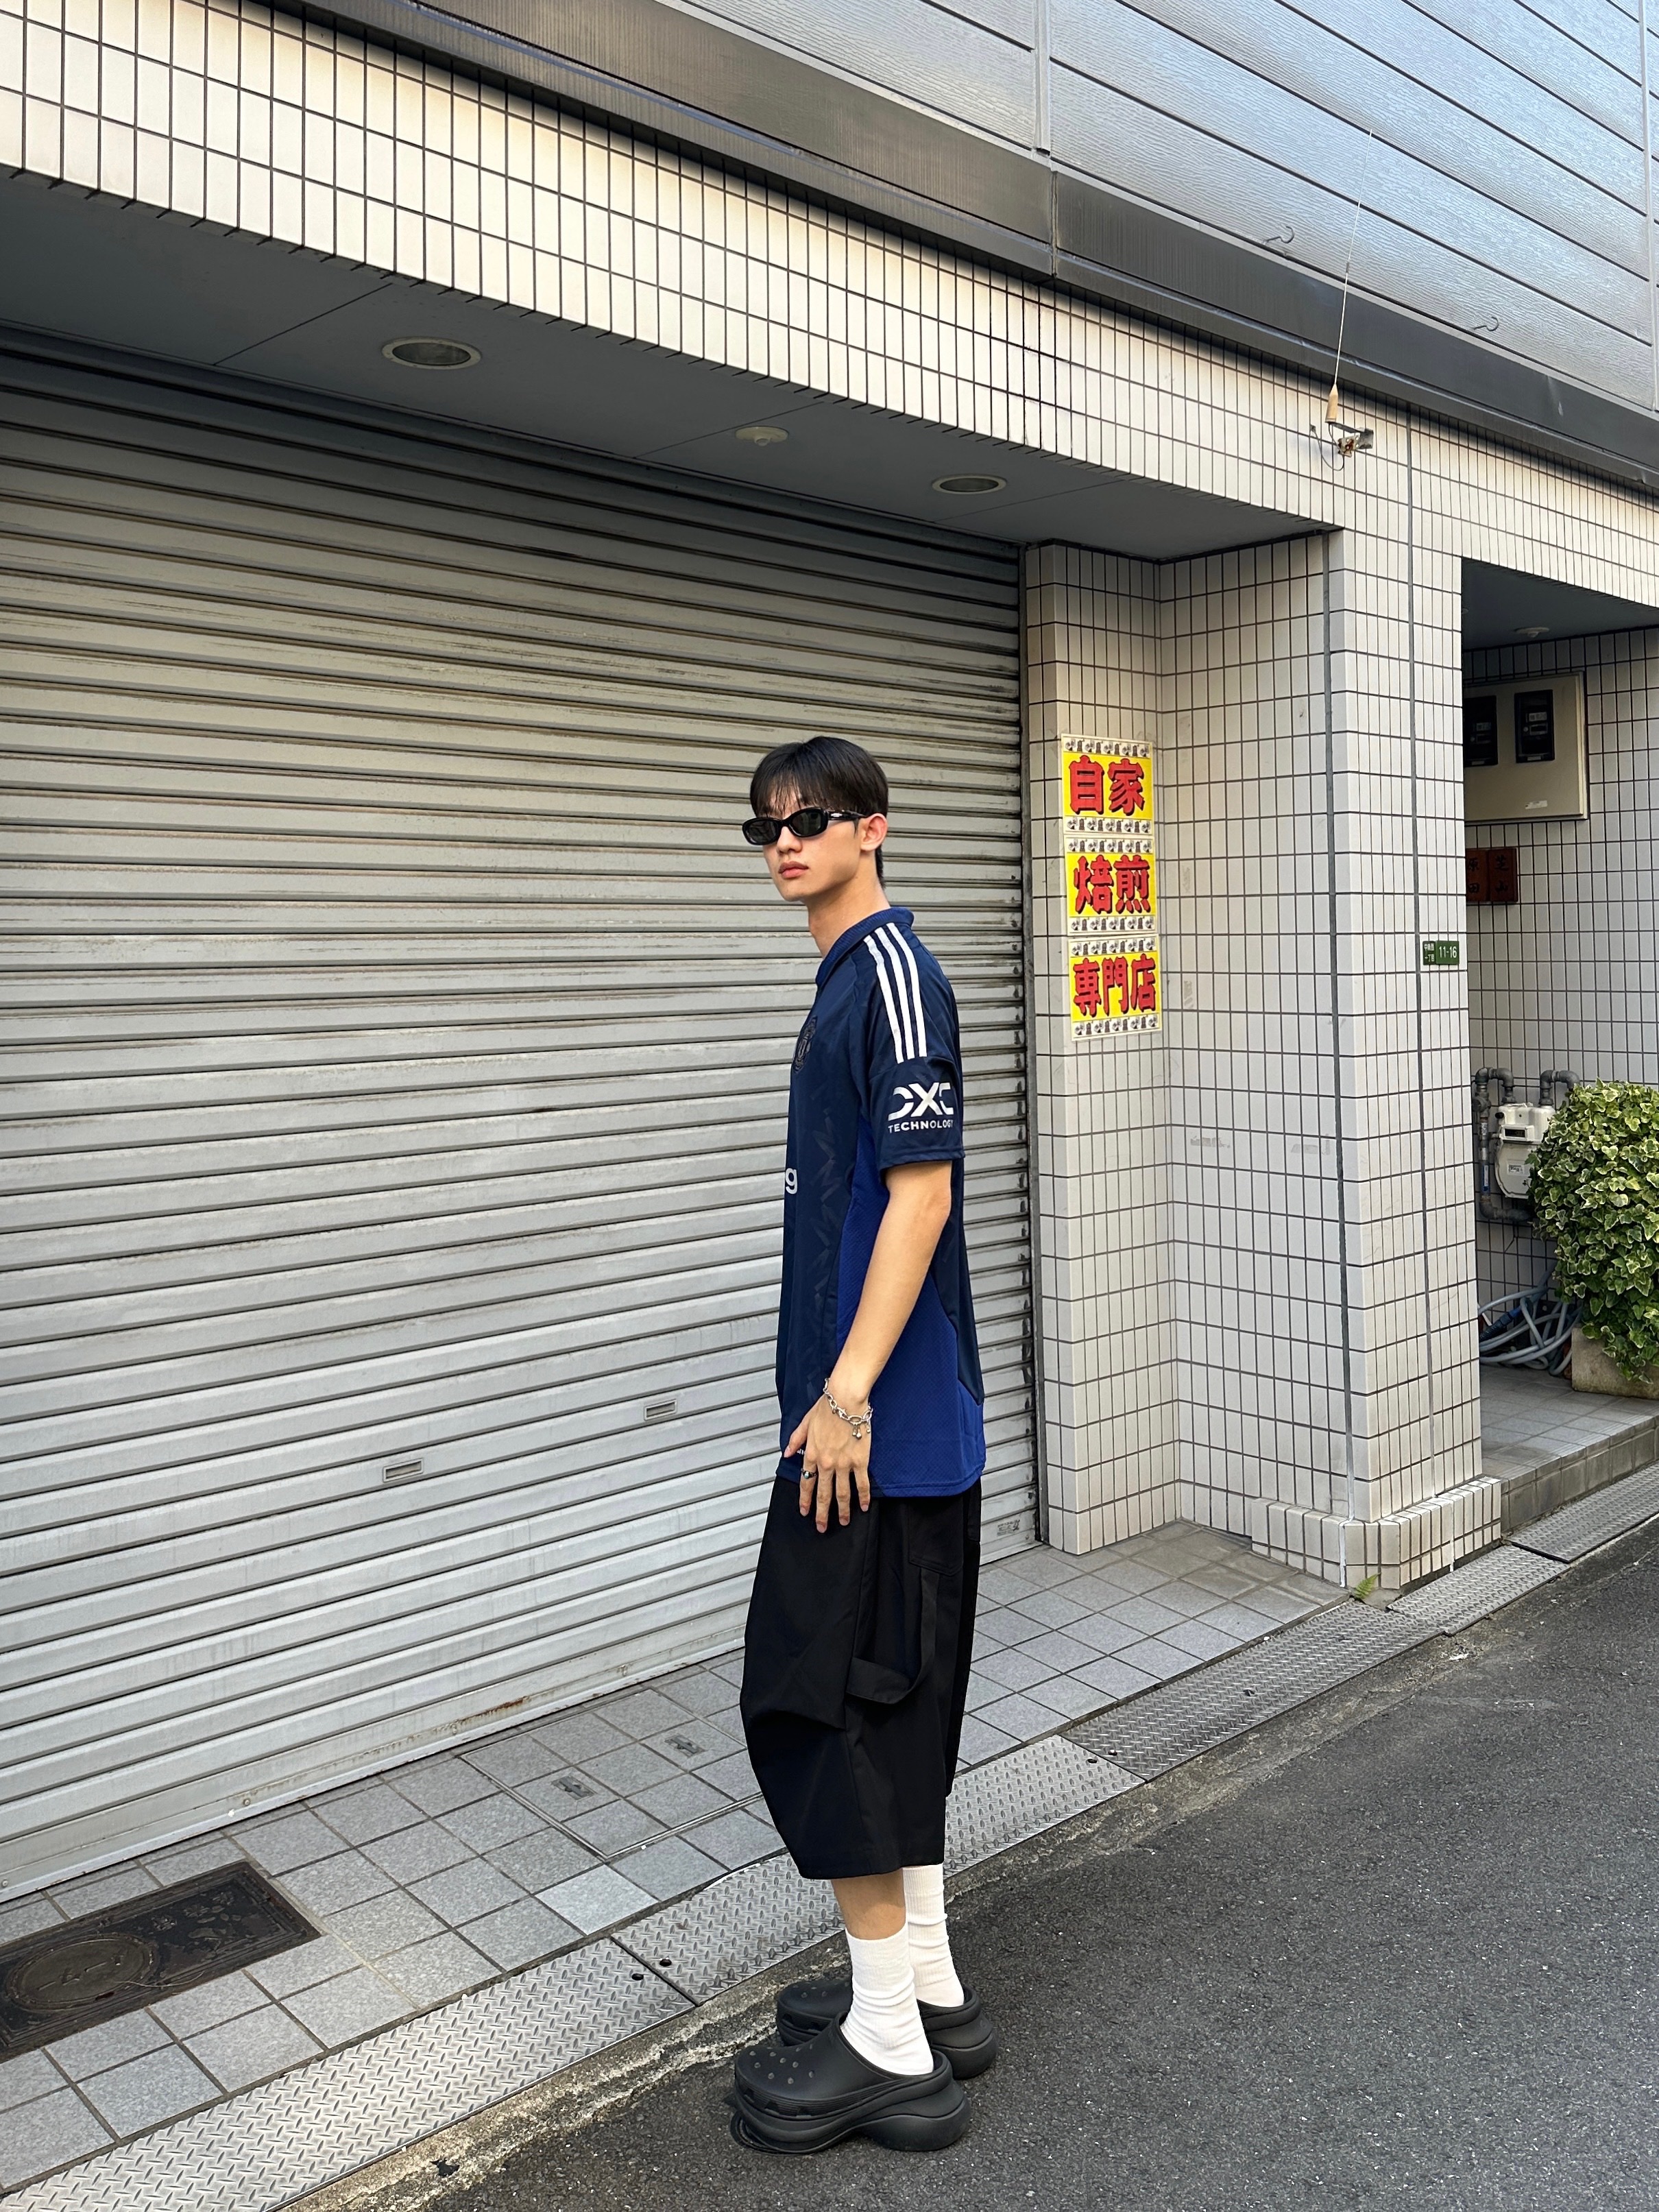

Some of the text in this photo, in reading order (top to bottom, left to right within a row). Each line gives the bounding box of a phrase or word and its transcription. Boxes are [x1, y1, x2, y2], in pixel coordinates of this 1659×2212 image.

[1069, 755, 1144, 816] 自家
[1073, 854, 1150, 913] 焙煎
[1439, 946, 1457, 959] 11-16
[1073, 953, 1155, 1016] 専門店
[888, 1082, 954, 1121] DXC
[888, 1119, 954, 1133] TECHNOLOGY
